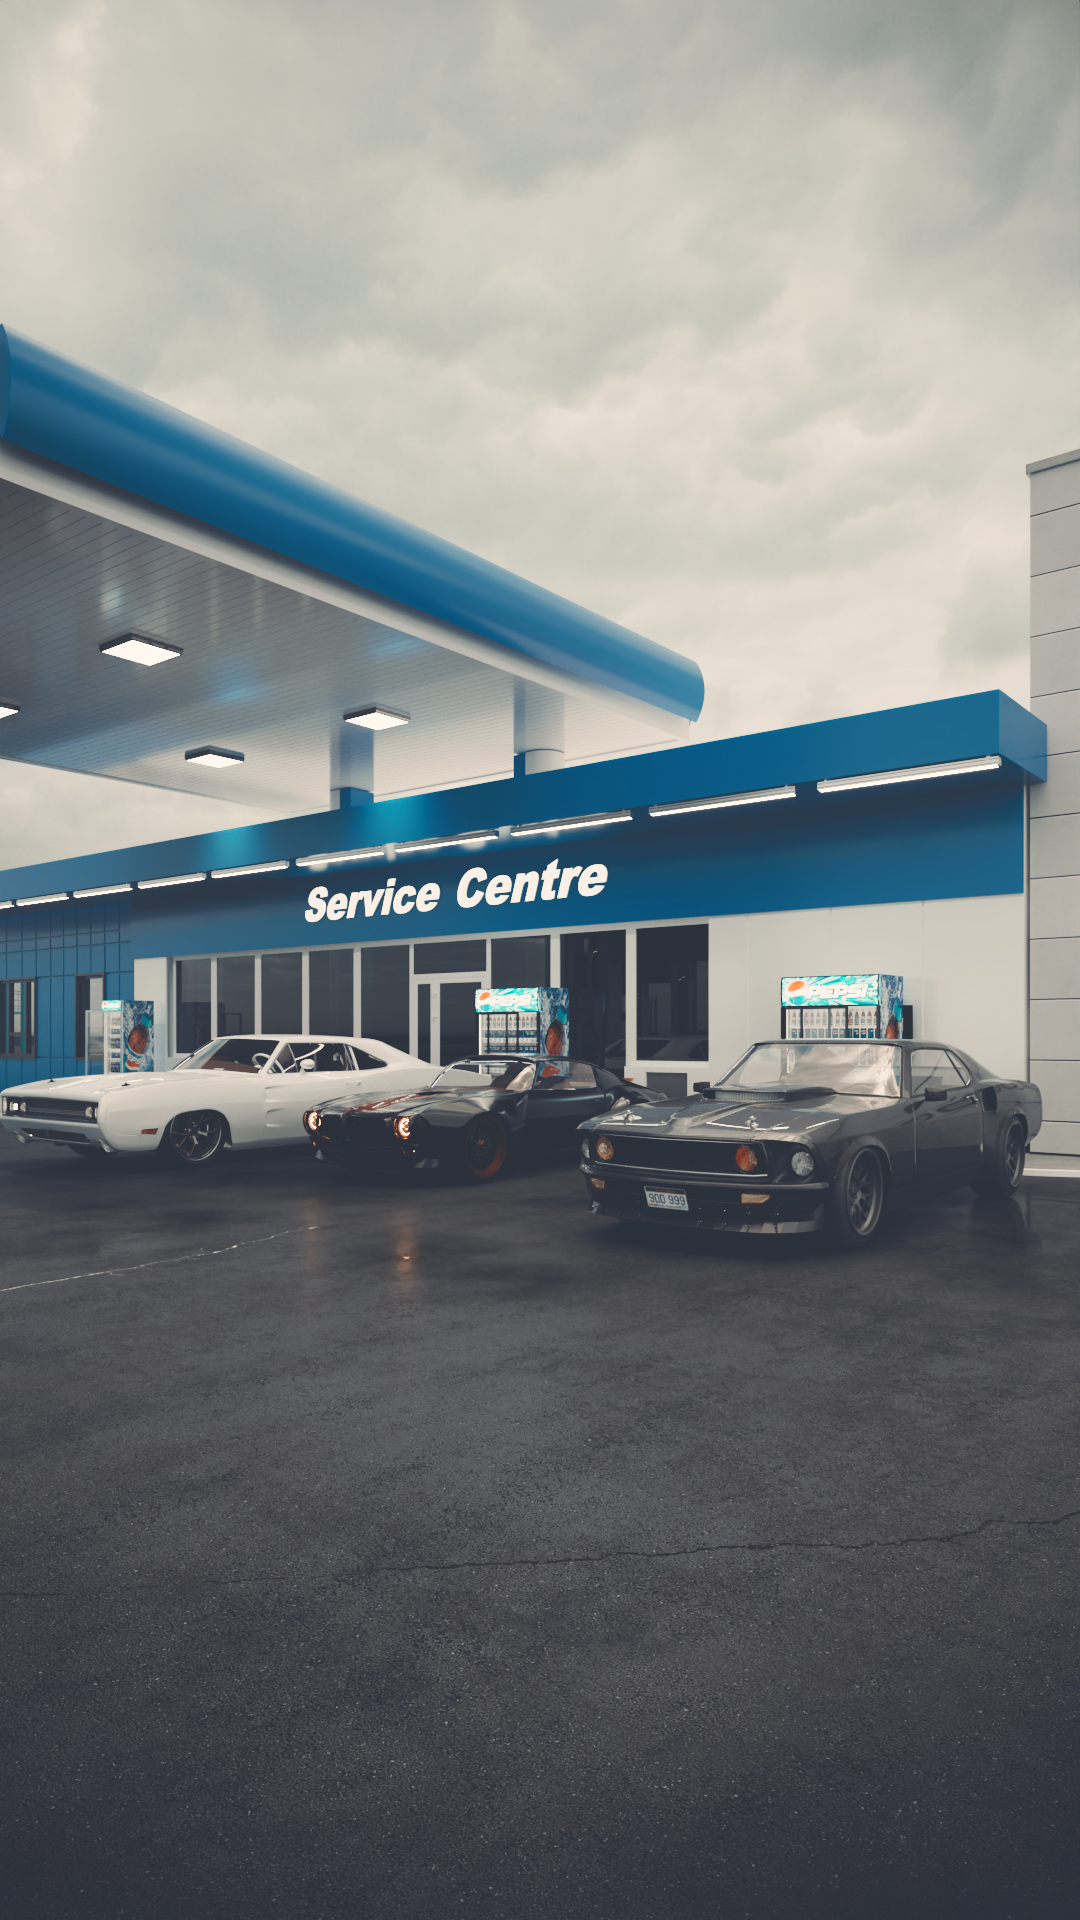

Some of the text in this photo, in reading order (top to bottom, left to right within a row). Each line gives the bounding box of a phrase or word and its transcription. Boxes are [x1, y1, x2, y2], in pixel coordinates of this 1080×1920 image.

[304, 858, 609, 923] Service Centre
[806, 984, 868, 999] PEPSI
[668, 1194, 686, 1206] 999
